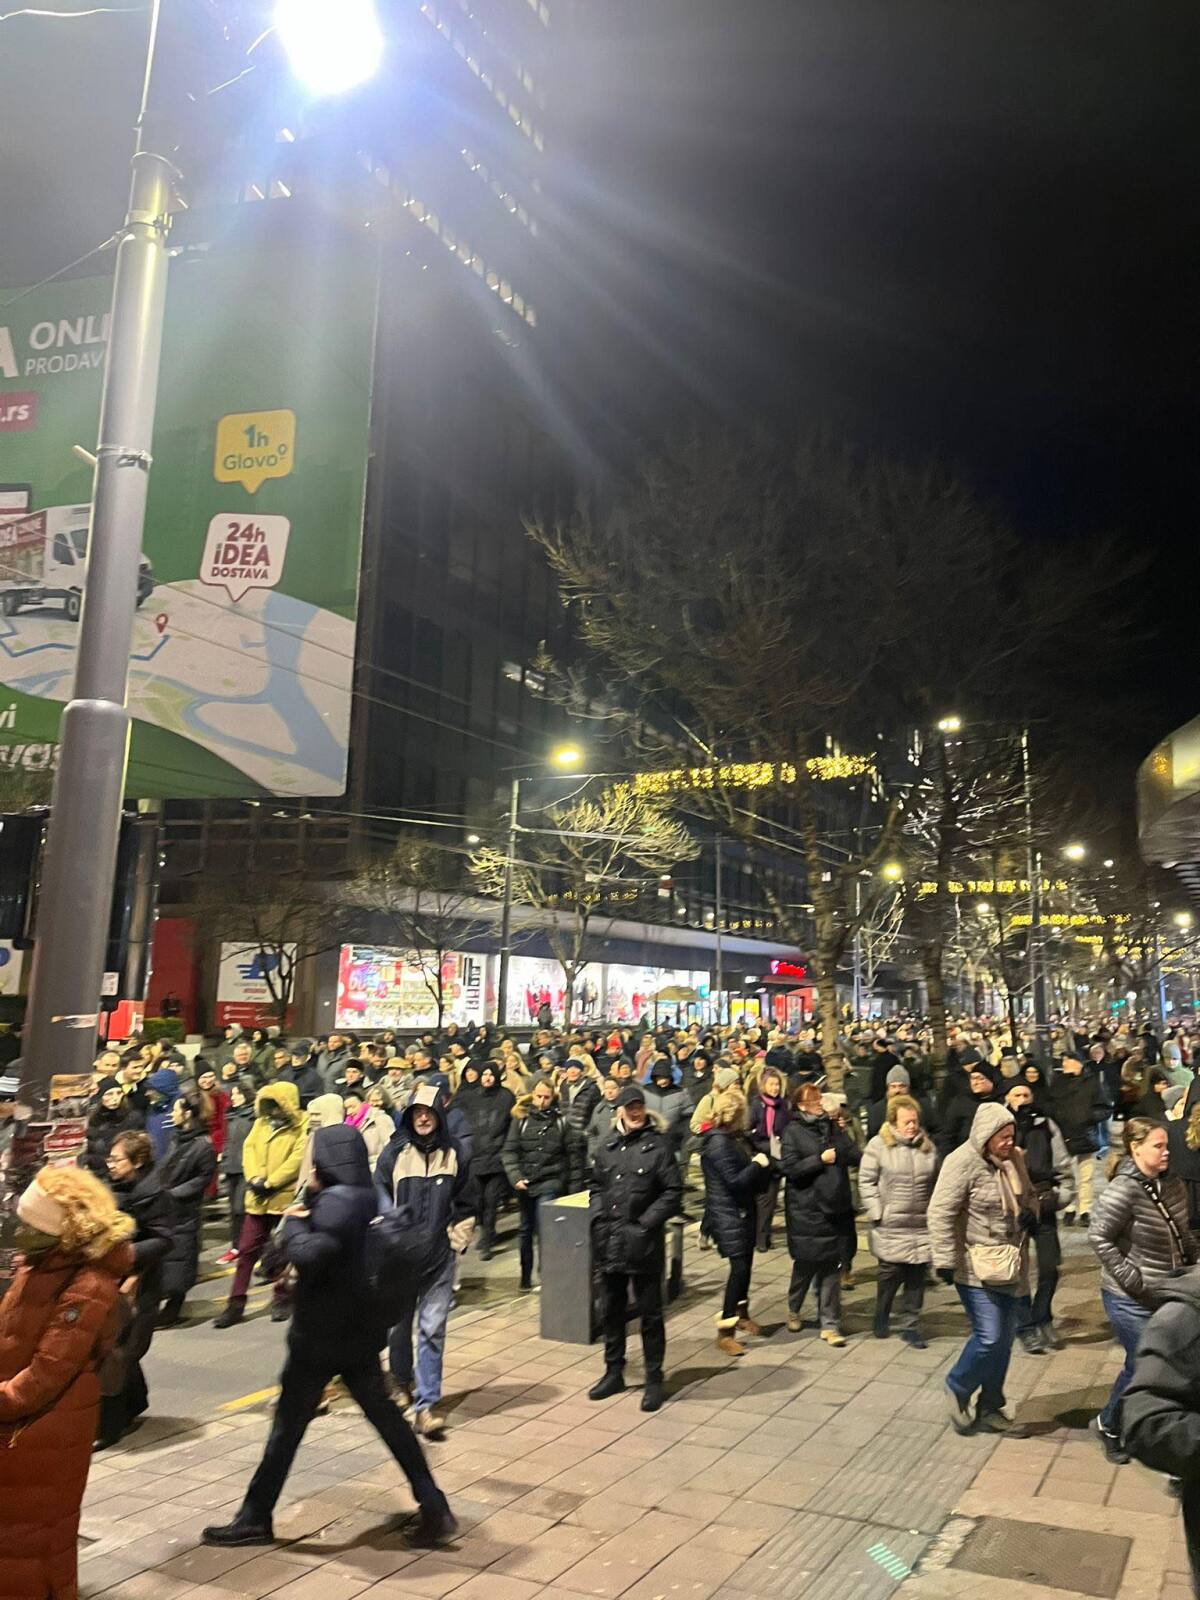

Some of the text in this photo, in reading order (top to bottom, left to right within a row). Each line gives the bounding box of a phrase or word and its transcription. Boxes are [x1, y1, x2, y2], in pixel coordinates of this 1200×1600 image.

[243, 424, 269, 448] 1h
[223, 454, 278, 470] Glovo
[226, 522, 266, 542] 24h
[213, 543, 271, 566] iDEA
[211, 567, 269, 579] DOSTAVA
